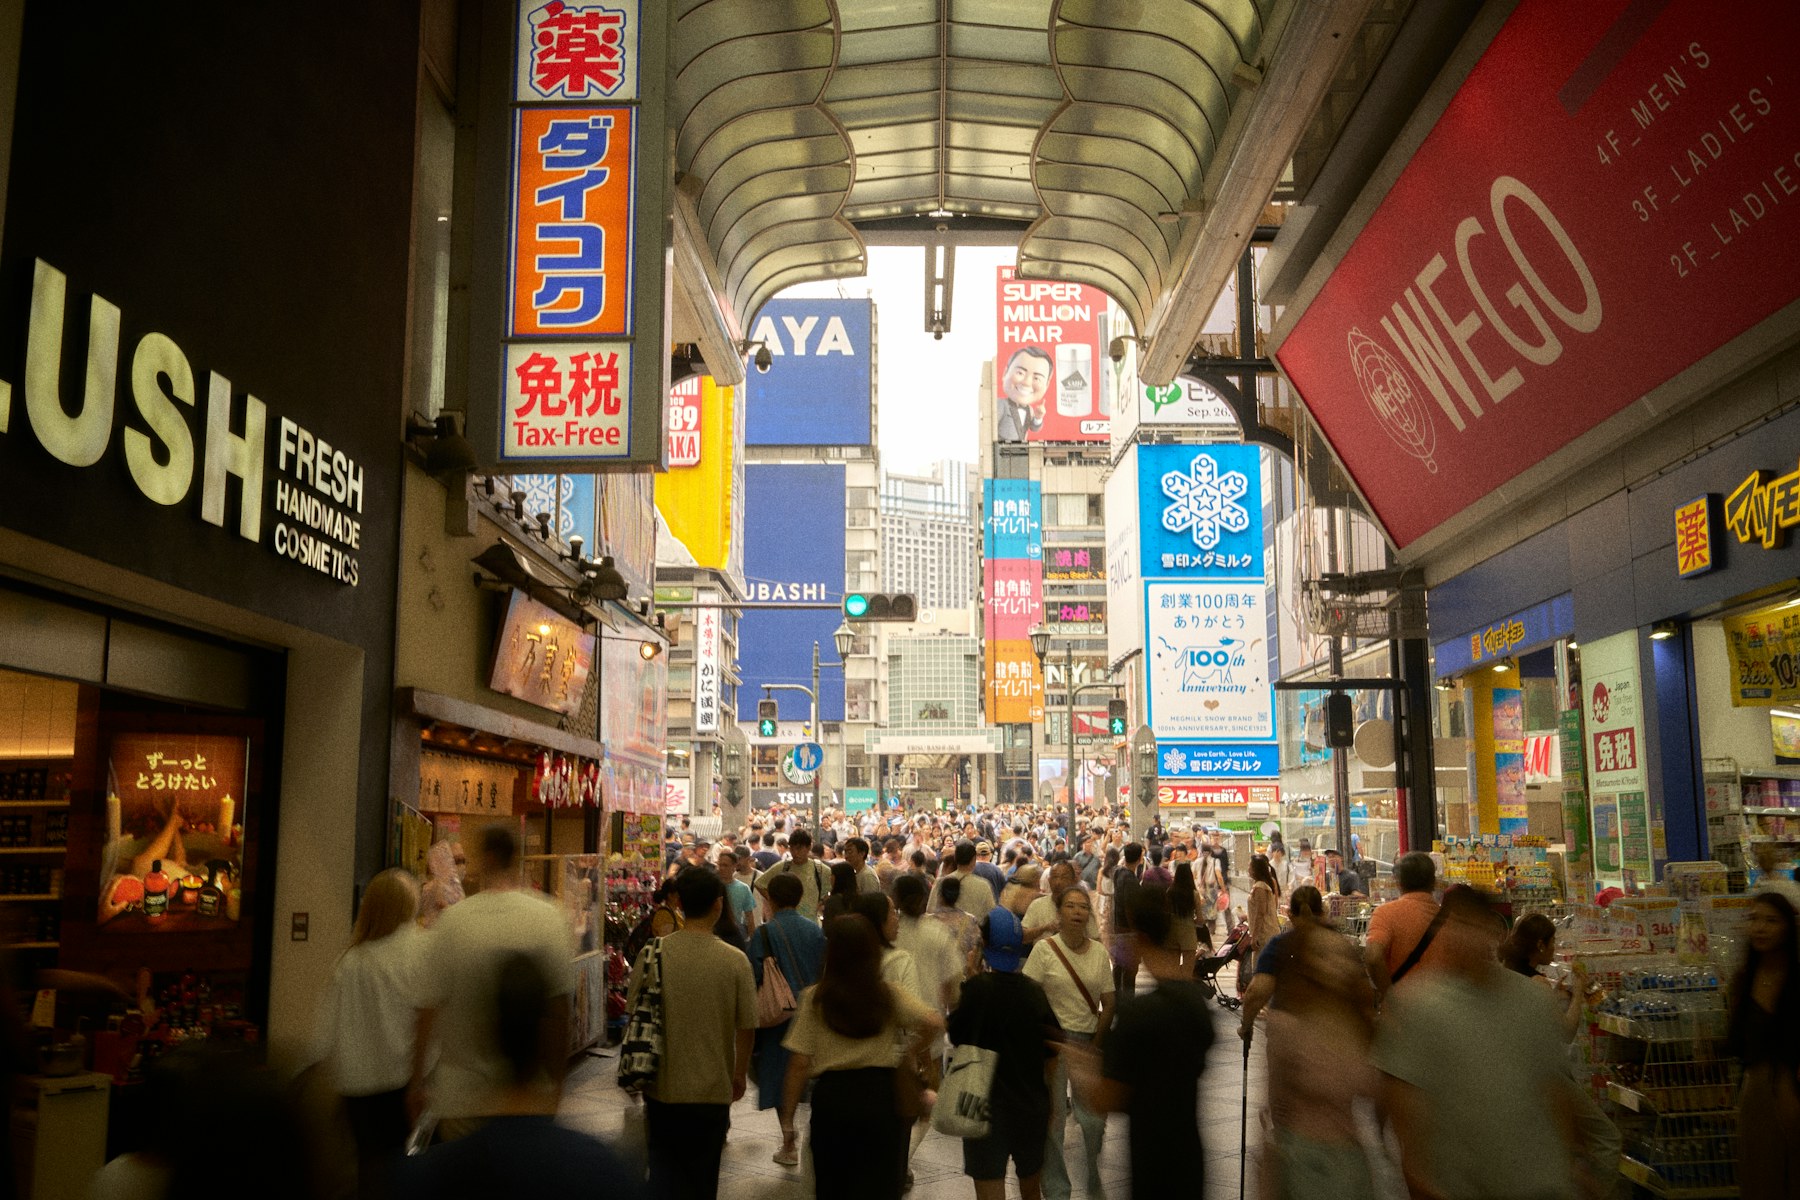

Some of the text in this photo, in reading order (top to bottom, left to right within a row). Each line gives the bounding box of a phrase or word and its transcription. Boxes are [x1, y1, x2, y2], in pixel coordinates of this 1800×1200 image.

[528, 1, 626, 98] 薬
[533, 115, 614, 329] ダイコク
[1003, 283, 1082, 301] SUPER
[1003, 305, 1091, 322] MILLION
[1380, 176, 1602, 433] WEGO
[1003, 325, 1063, 343] HAIR
[515, 351, 621, 418] 免税
[0, 256, 267, 544] USH
[513, 421, 620, 446] Tax-Free
[280, 416, 363, 514] FRESH
[275, 479, 360, 550] HANDMADE
[1678, 505, 1708, 571] 薬
[274, 522, 359, 587] COSMETICS
[1161, 552, 1252, 568] 雪印メグミルク
[1161, 593, 1257, 608] 創業100周年
[1174, 614, 1245, 629] ありがとう
[1190, 650, 1245, 667] 100th
[1180, 683, 1247, 695] Anniversary
[1599, 732, 1633, 771] 免税
[145, 752, 206, 771] ずーっと
[1190, 758, 1261, 772] 雪印メグミルク
[136, 772, 217, 790] とろけたい
[1177, 790, 1244, 803] ZETTERIA
